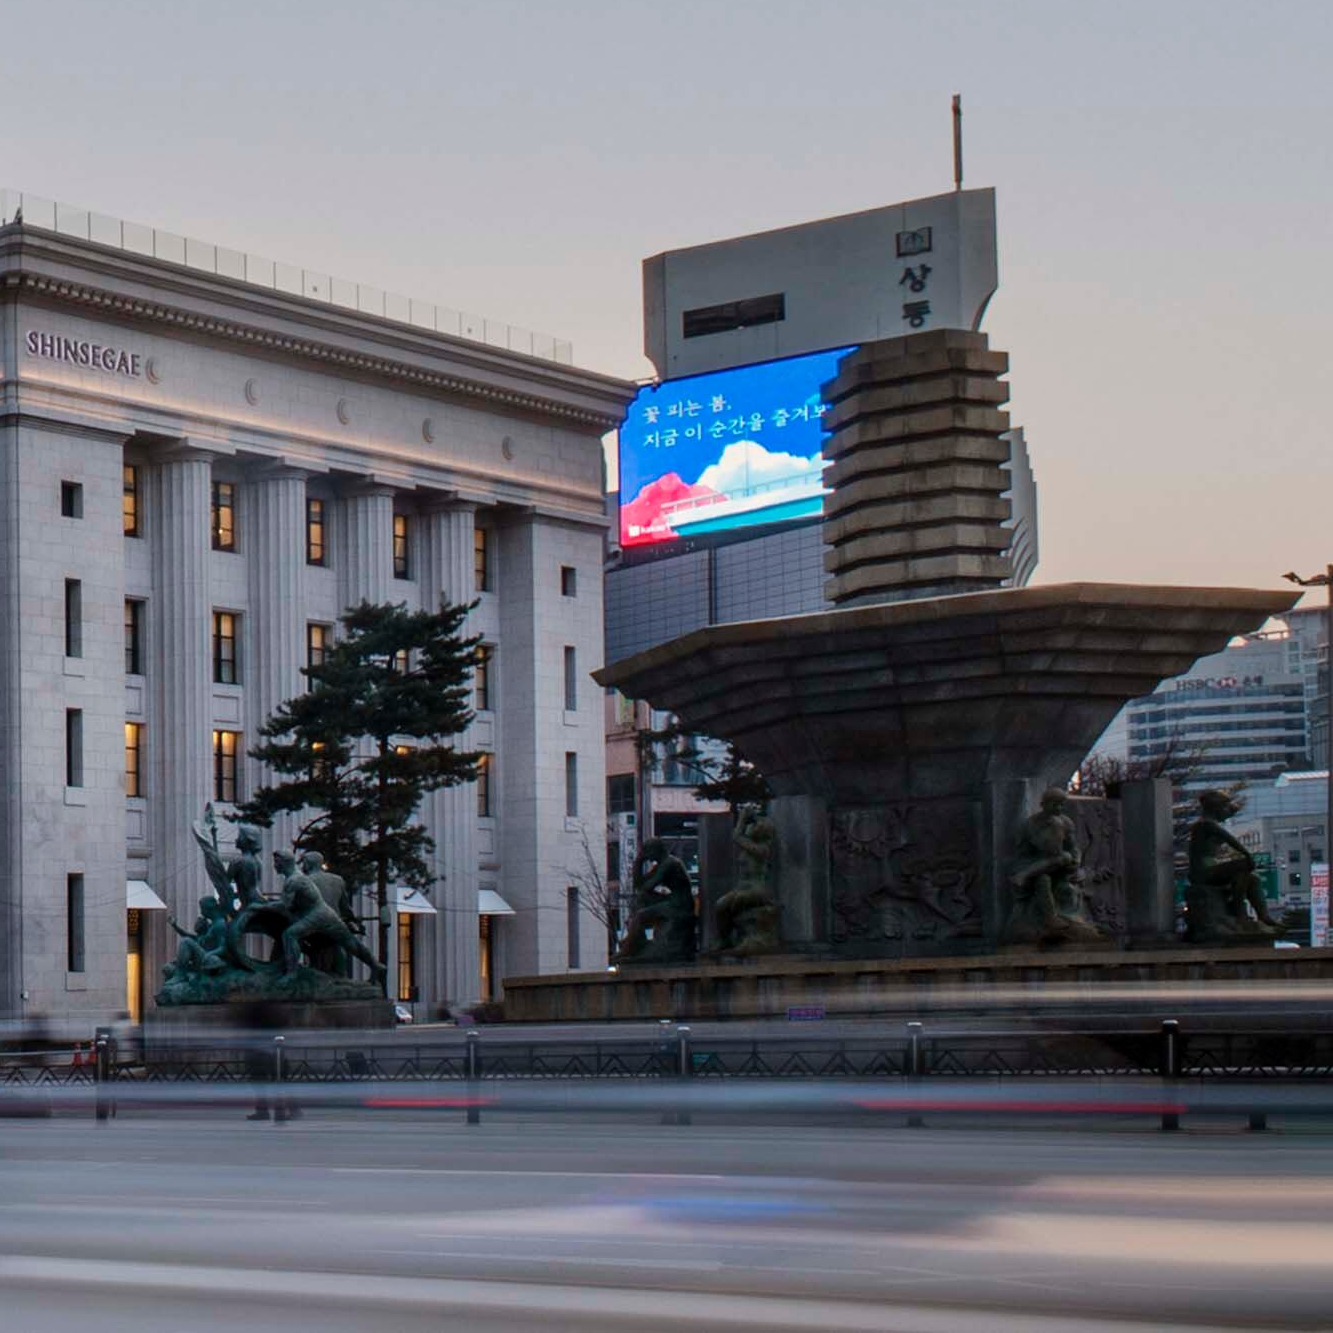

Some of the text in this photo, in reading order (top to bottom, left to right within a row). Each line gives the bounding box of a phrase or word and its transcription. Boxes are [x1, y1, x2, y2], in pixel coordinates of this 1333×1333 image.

[27, 330, 141, 377] SHINSEGAE
[643, 405, 662, 424] 꽃
[667, 400, 703, 417] 피는
[643, 427, 680, 448] 지금
[685, 423, 703, 441] 이
[709, 413, 766, 439] 순간을
